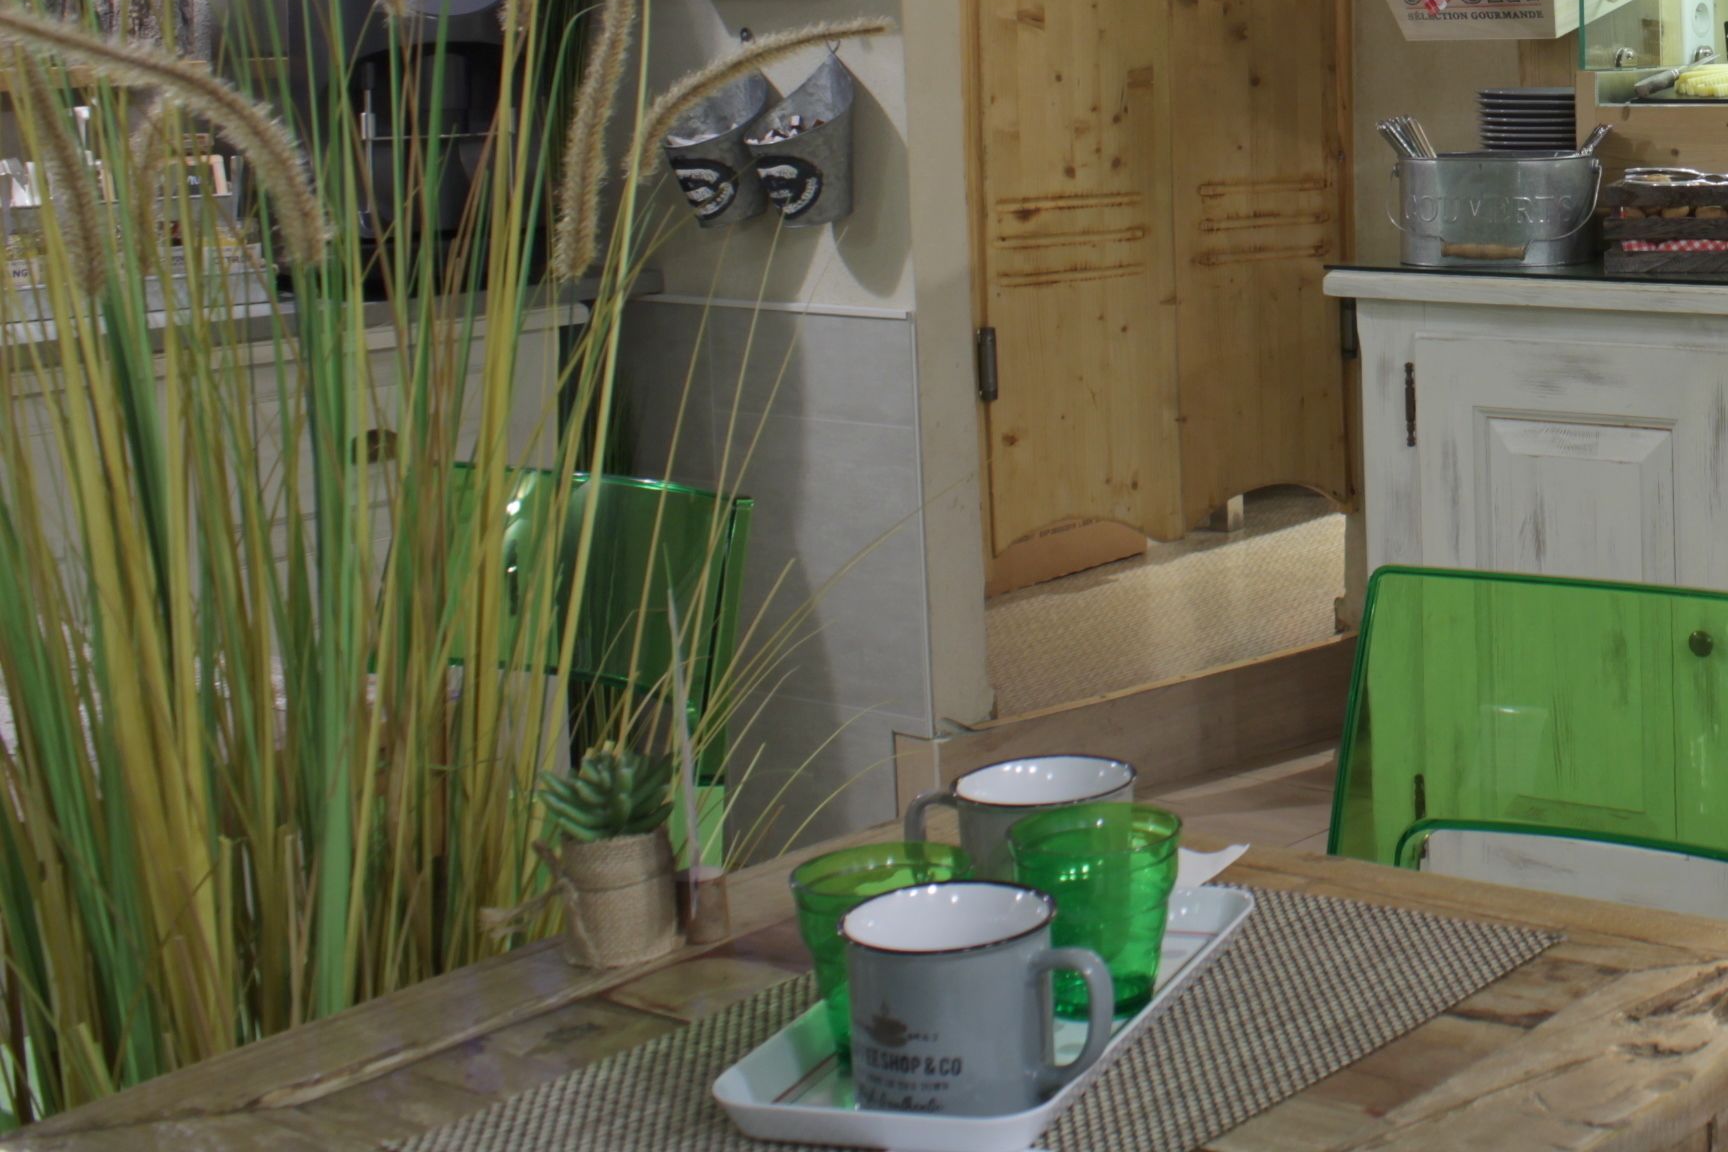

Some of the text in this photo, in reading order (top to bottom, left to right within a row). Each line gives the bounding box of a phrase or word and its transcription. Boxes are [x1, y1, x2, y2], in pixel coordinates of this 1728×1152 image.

[1471, 10, 1544, 20] GOURMANDE
[924, 1056, 936, 1076] &
[940, 1056, 962, 1077] CO
